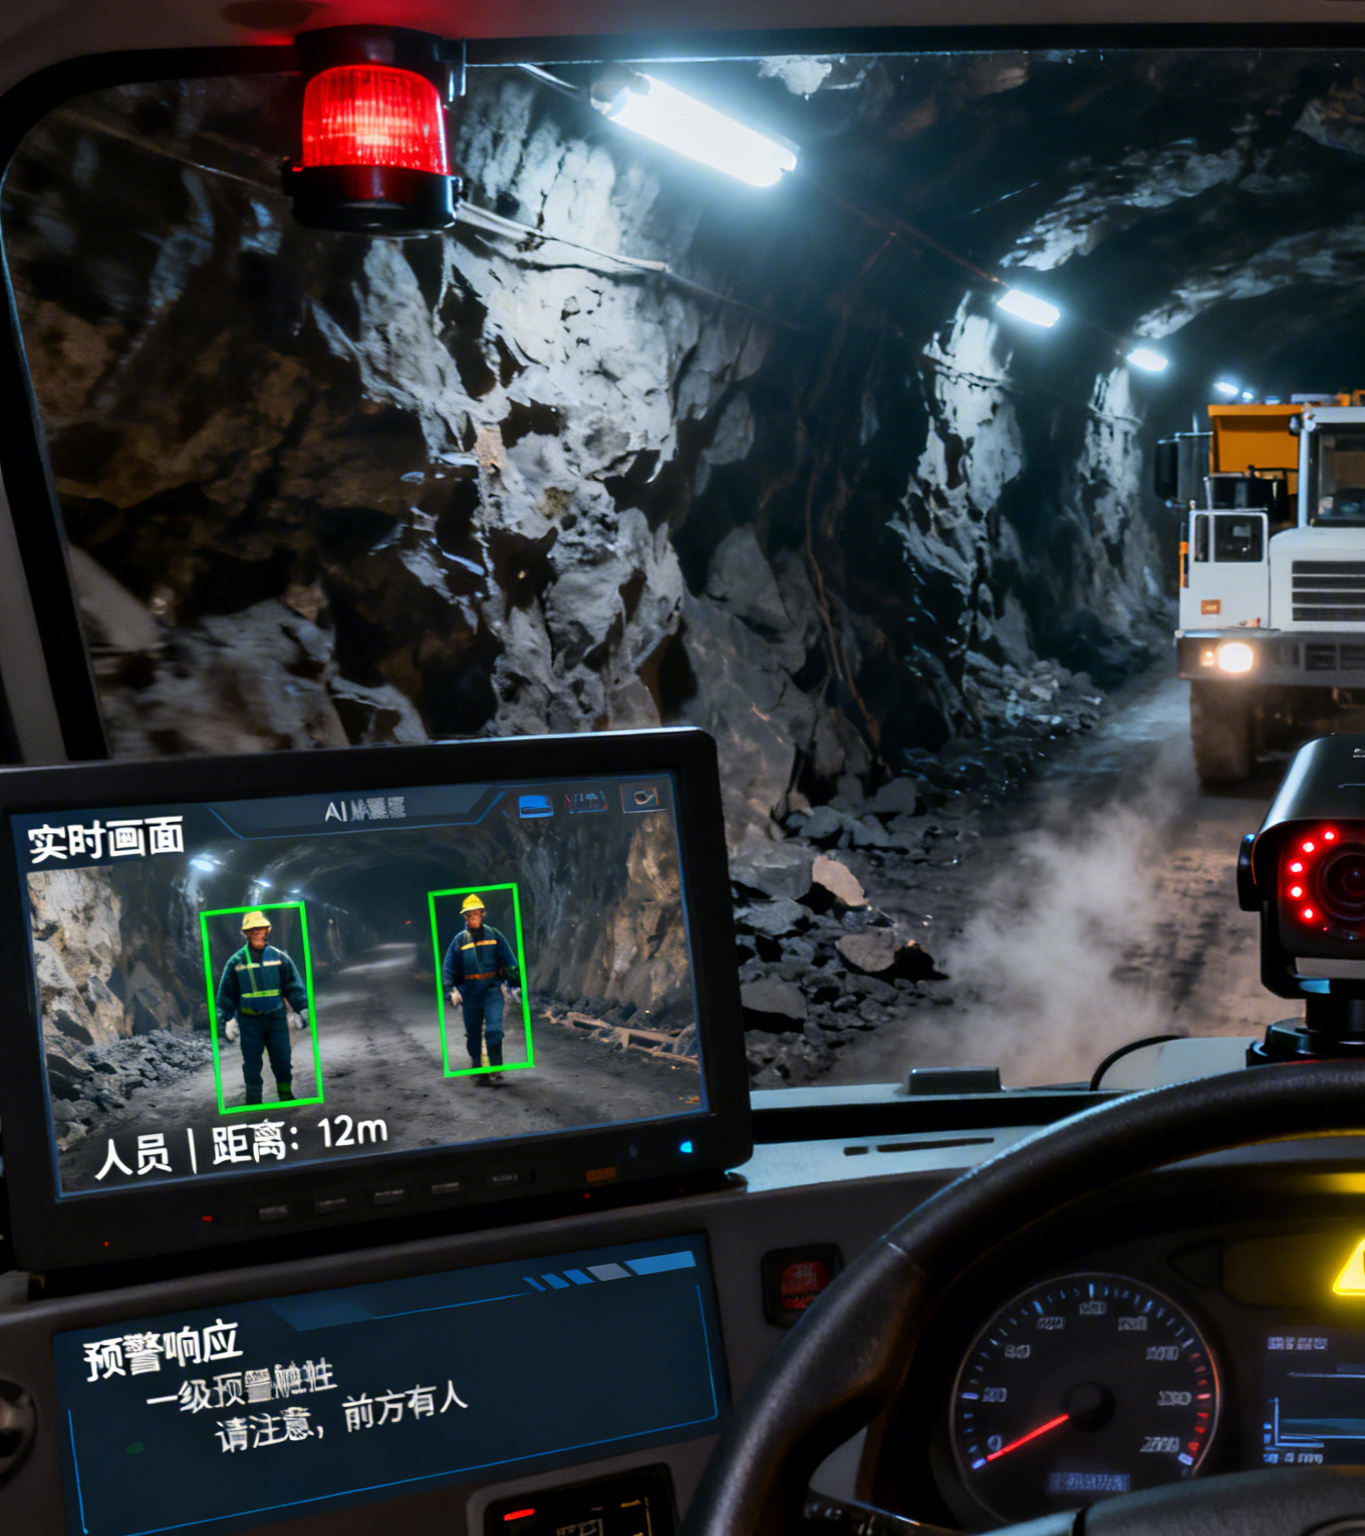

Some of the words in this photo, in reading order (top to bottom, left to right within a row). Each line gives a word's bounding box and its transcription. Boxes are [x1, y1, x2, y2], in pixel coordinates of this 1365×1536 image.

[27, 815, 185, 864] 实时画面
[94, 1133, 172, 1181] 人员
[83, 1318, 244, 1382] 预警响应
